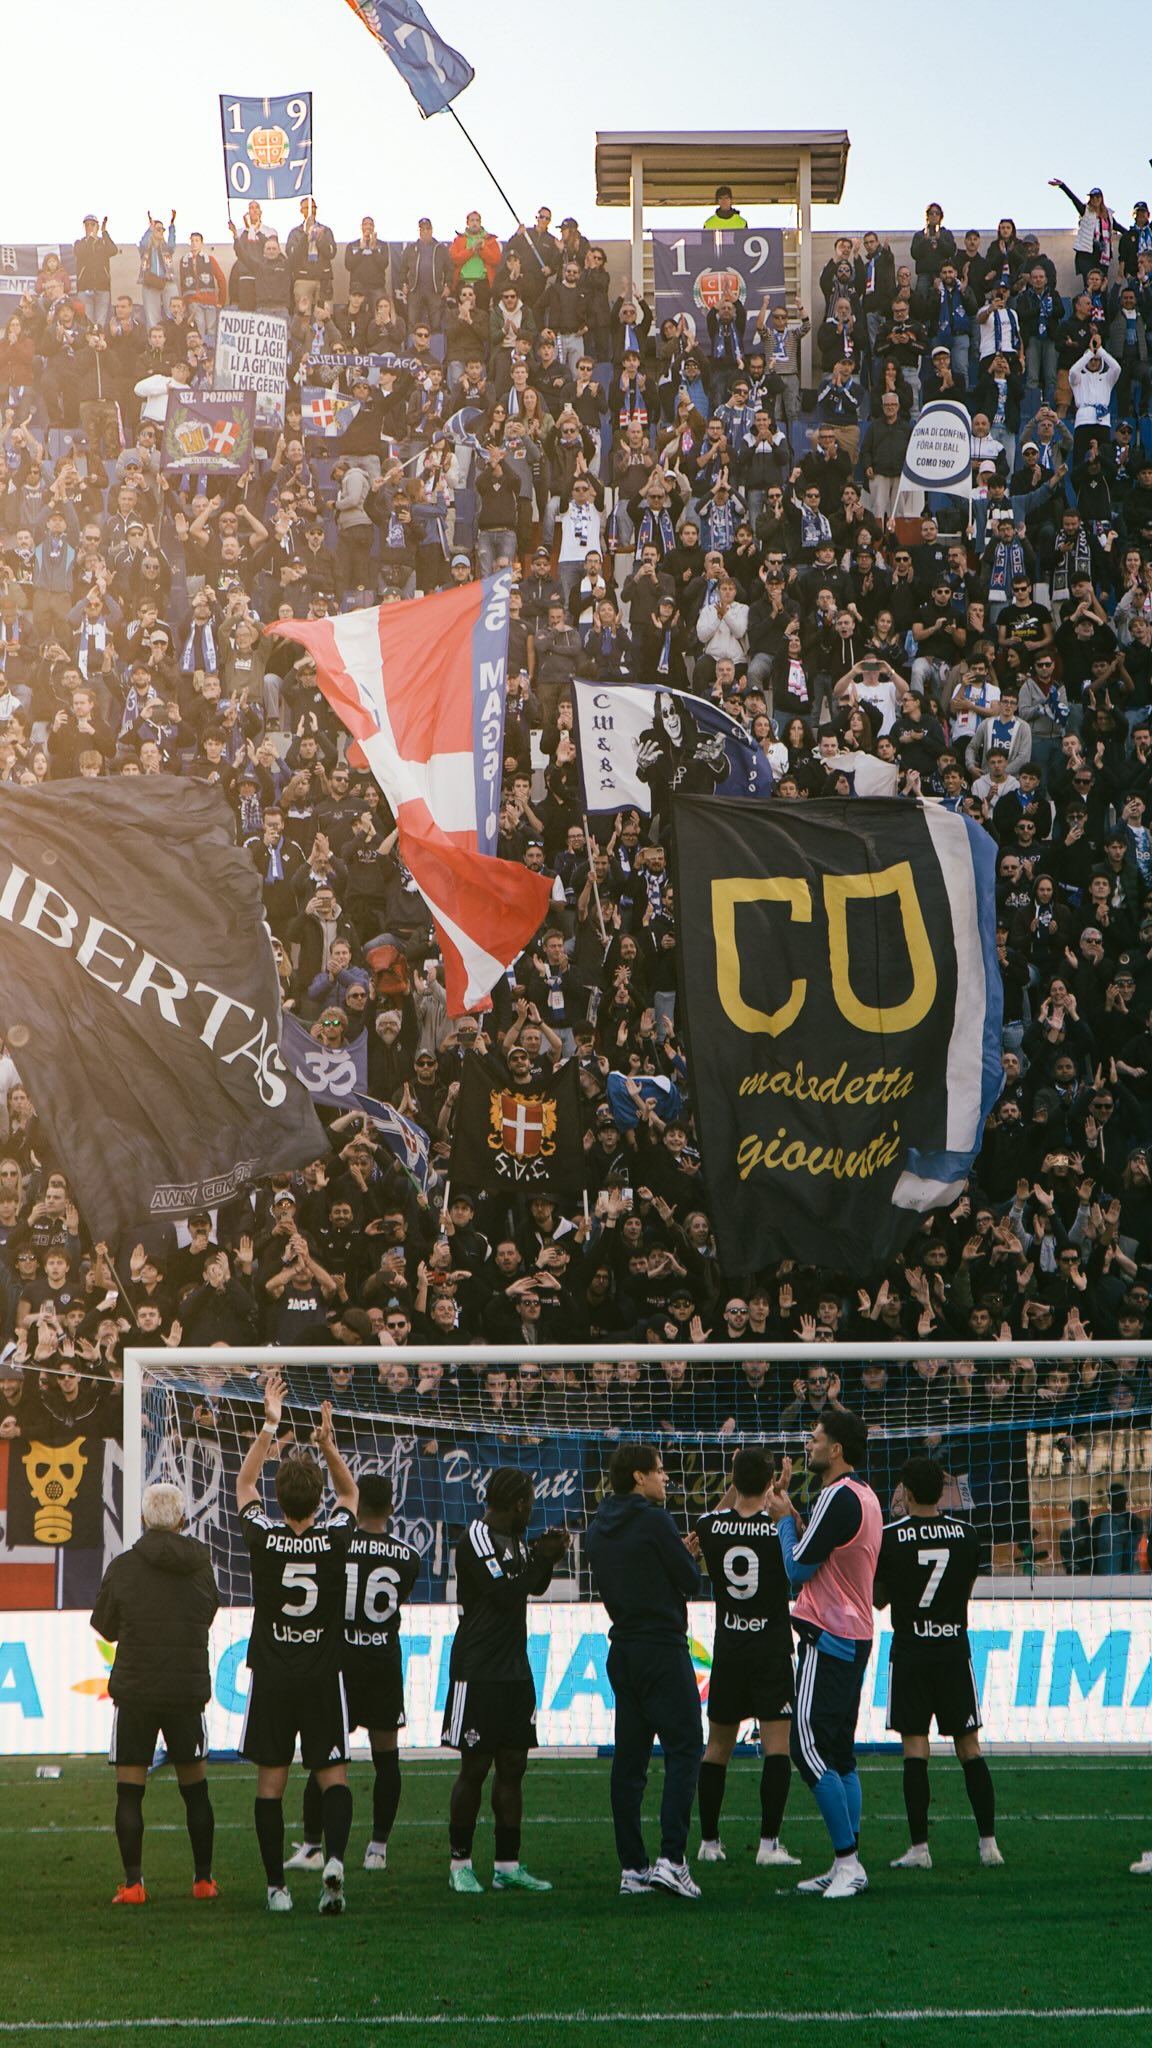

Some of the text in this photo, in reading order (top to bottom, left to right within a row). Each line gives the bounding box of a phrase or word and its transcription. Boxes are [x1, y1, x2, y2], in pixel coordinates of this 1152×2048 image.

[227, 99, 307, 133] 1 9
[230, 158, 308, 193] 0 7
[669, 235, 769, 276] 1 9
[237, 336, 252, 353] UL
[307, 354, 418, 369] QUELLI DEL LAGO
[202, 391, 244, 402] POZIONE
[930, 427, 938, 436] DI
[939, 428, 967, 441] CONFINE
[934, 441, 942, 450] DI
[943, 442, 960, 453] BALL
[916, 457, 955, 469] COMO 1907
[0, 863, 287, 1108] IBERTAS
[739, 1060, 914, 1105] maledetta
[150, 1188, 198, 1208] AWAY
[443, 1449, 579, 1504] Difati
[711, 1520, 778, 1537] DOUVIKAS
[897, 1524, 965, 1542] DA CUNHA
[266, 1535, 331, 1554] PERRONE
[348, 1540, 410, 1561] IKI BRUNO
[723, 1545, 760, 1600] 9
[918, 1548, 950, 1608] 7
[281, 1562, 319, 1617] 5
[344, 1562, 401, 1624] 16
[724, 1612, 768, 1632] Uber
[913, 1620, 962, 1637] Uber
[272, 1622, 324, 1643] Uber
[344, 1628, 389, 1646] Uber
